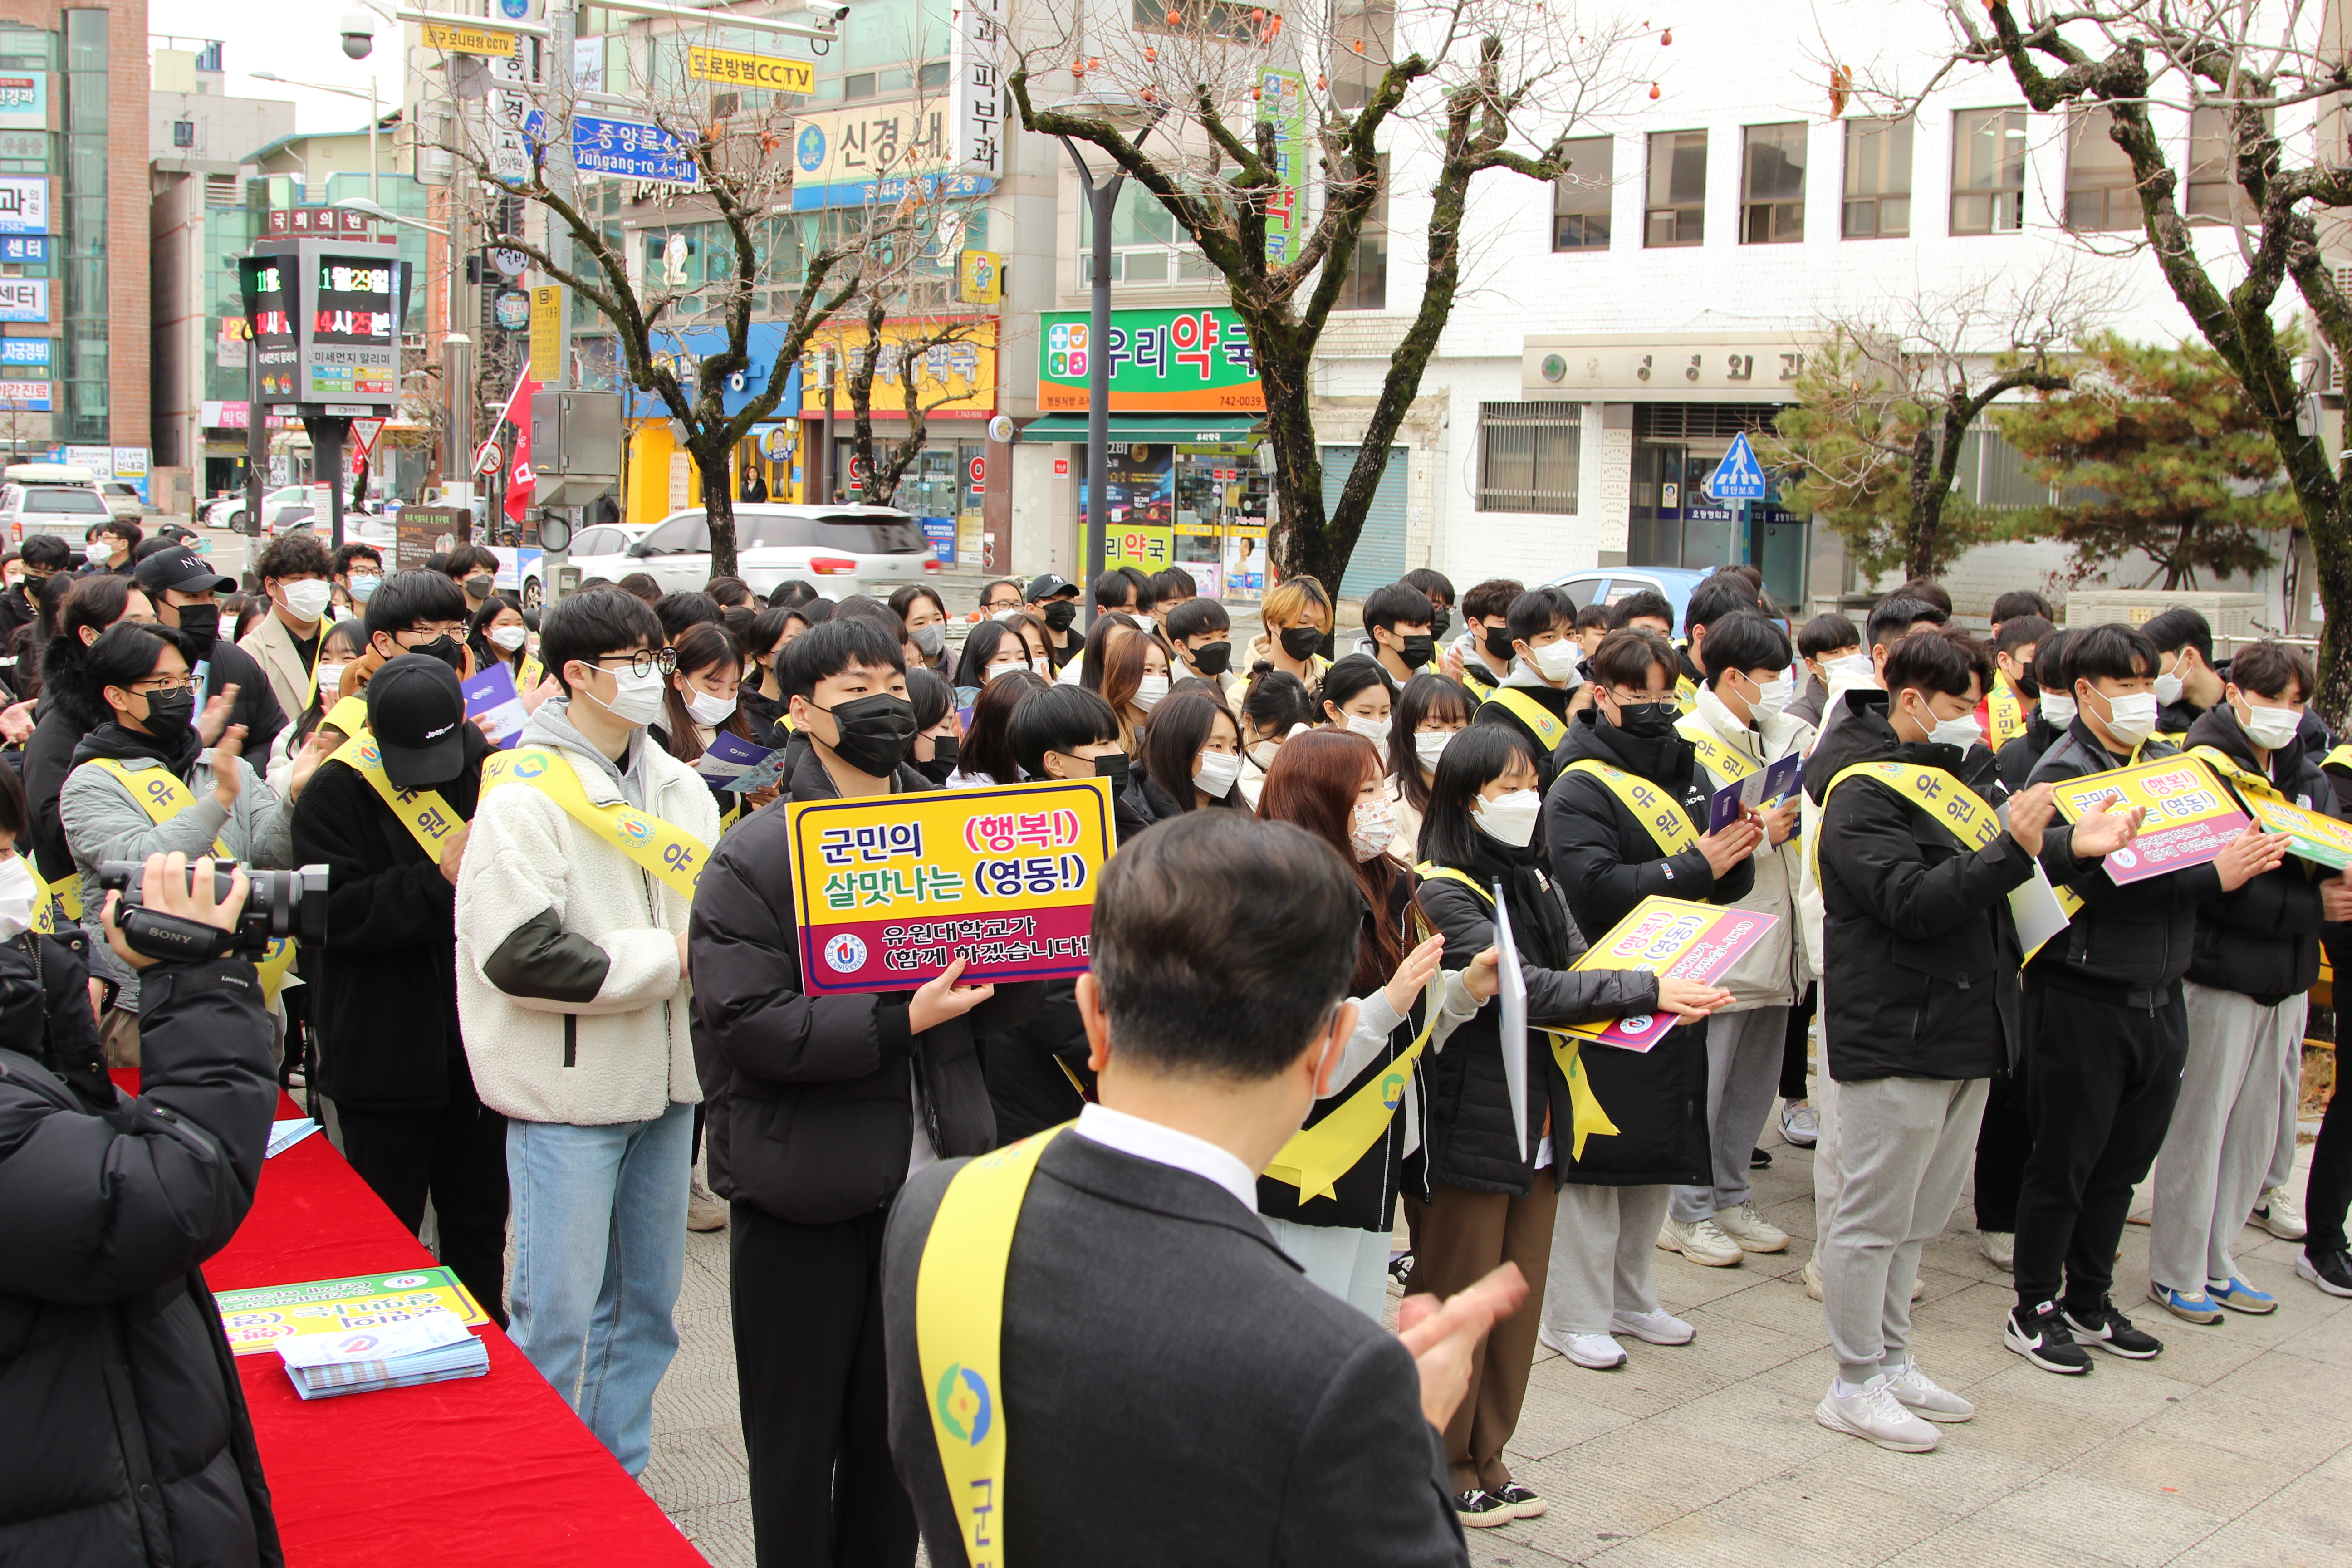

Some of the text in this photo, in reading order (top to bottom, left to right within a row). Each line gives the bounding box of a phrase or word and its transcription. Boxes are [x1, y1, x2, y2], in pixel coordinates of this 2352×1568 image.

[449, 33, 484, 49] 모니터링
[487, 38, 509, 50] CCTV
[694, 55, 809, 86] 도로방범CCTV
[971, 64, 998, 172] 피부과
[839, 111, 950, 171] 신경내
[577, 152, 655, 174] Jungang-ro
[802, 156, 821, 165] NPC
[274, 210, 362, 230] 국회의원
[6, 239, 42, 258] 센터
[318, 267, 390, 294] 1월29일
[0, 286, 36, 308] 센터
[314, 310, 391, 337] 14시25분
[1110, 311, 1259, 380] 우리약국
[259, 351, 297, 364] 미세먼지 알리미
[315, 353, 390, 369] 미세먼지 알리미
[23, 385, 48, 397] 진료
[1047, 396, 1075, 407] 병원처방
[1220, 396, 1261, 407] 742-0039
[223, 411, 249, 428] 박덕
[1196, 433, 1220, 441] 우리약국
[117, 461, 145, 470] 신내과
[1692, 510, 1730, 520] 오정형외과
[1235, 528, 1261, 536] 우리약국
[1105, 533, 1166, 563] 리약국
[426, 728, 445, 739] Jeep
[1997, 705, 2014, 741] 군민
[2140, 768, 2200, 798] (행복!)
[2159, 789, 2220, 821] (영동!)
[820, 808, 1081, 865] 군민의 (행복!)
[2134, 822, 2212, 851] 유원대학교가
[823, 853, 1088, 910] 살맛나는 (영동!)
[148, 927, 192, 944] SONY
[881, 915, 1037, 946] 유원대학교가
[1612, 911, 1676, 958] (행복!)
[1642, 915, 1706, 961] (영동!)
[883, 946, 947, 970] (함께
[305, 1281, 372, 1296] (함께
[293, 1293, 442, 1318] 살맛나는
